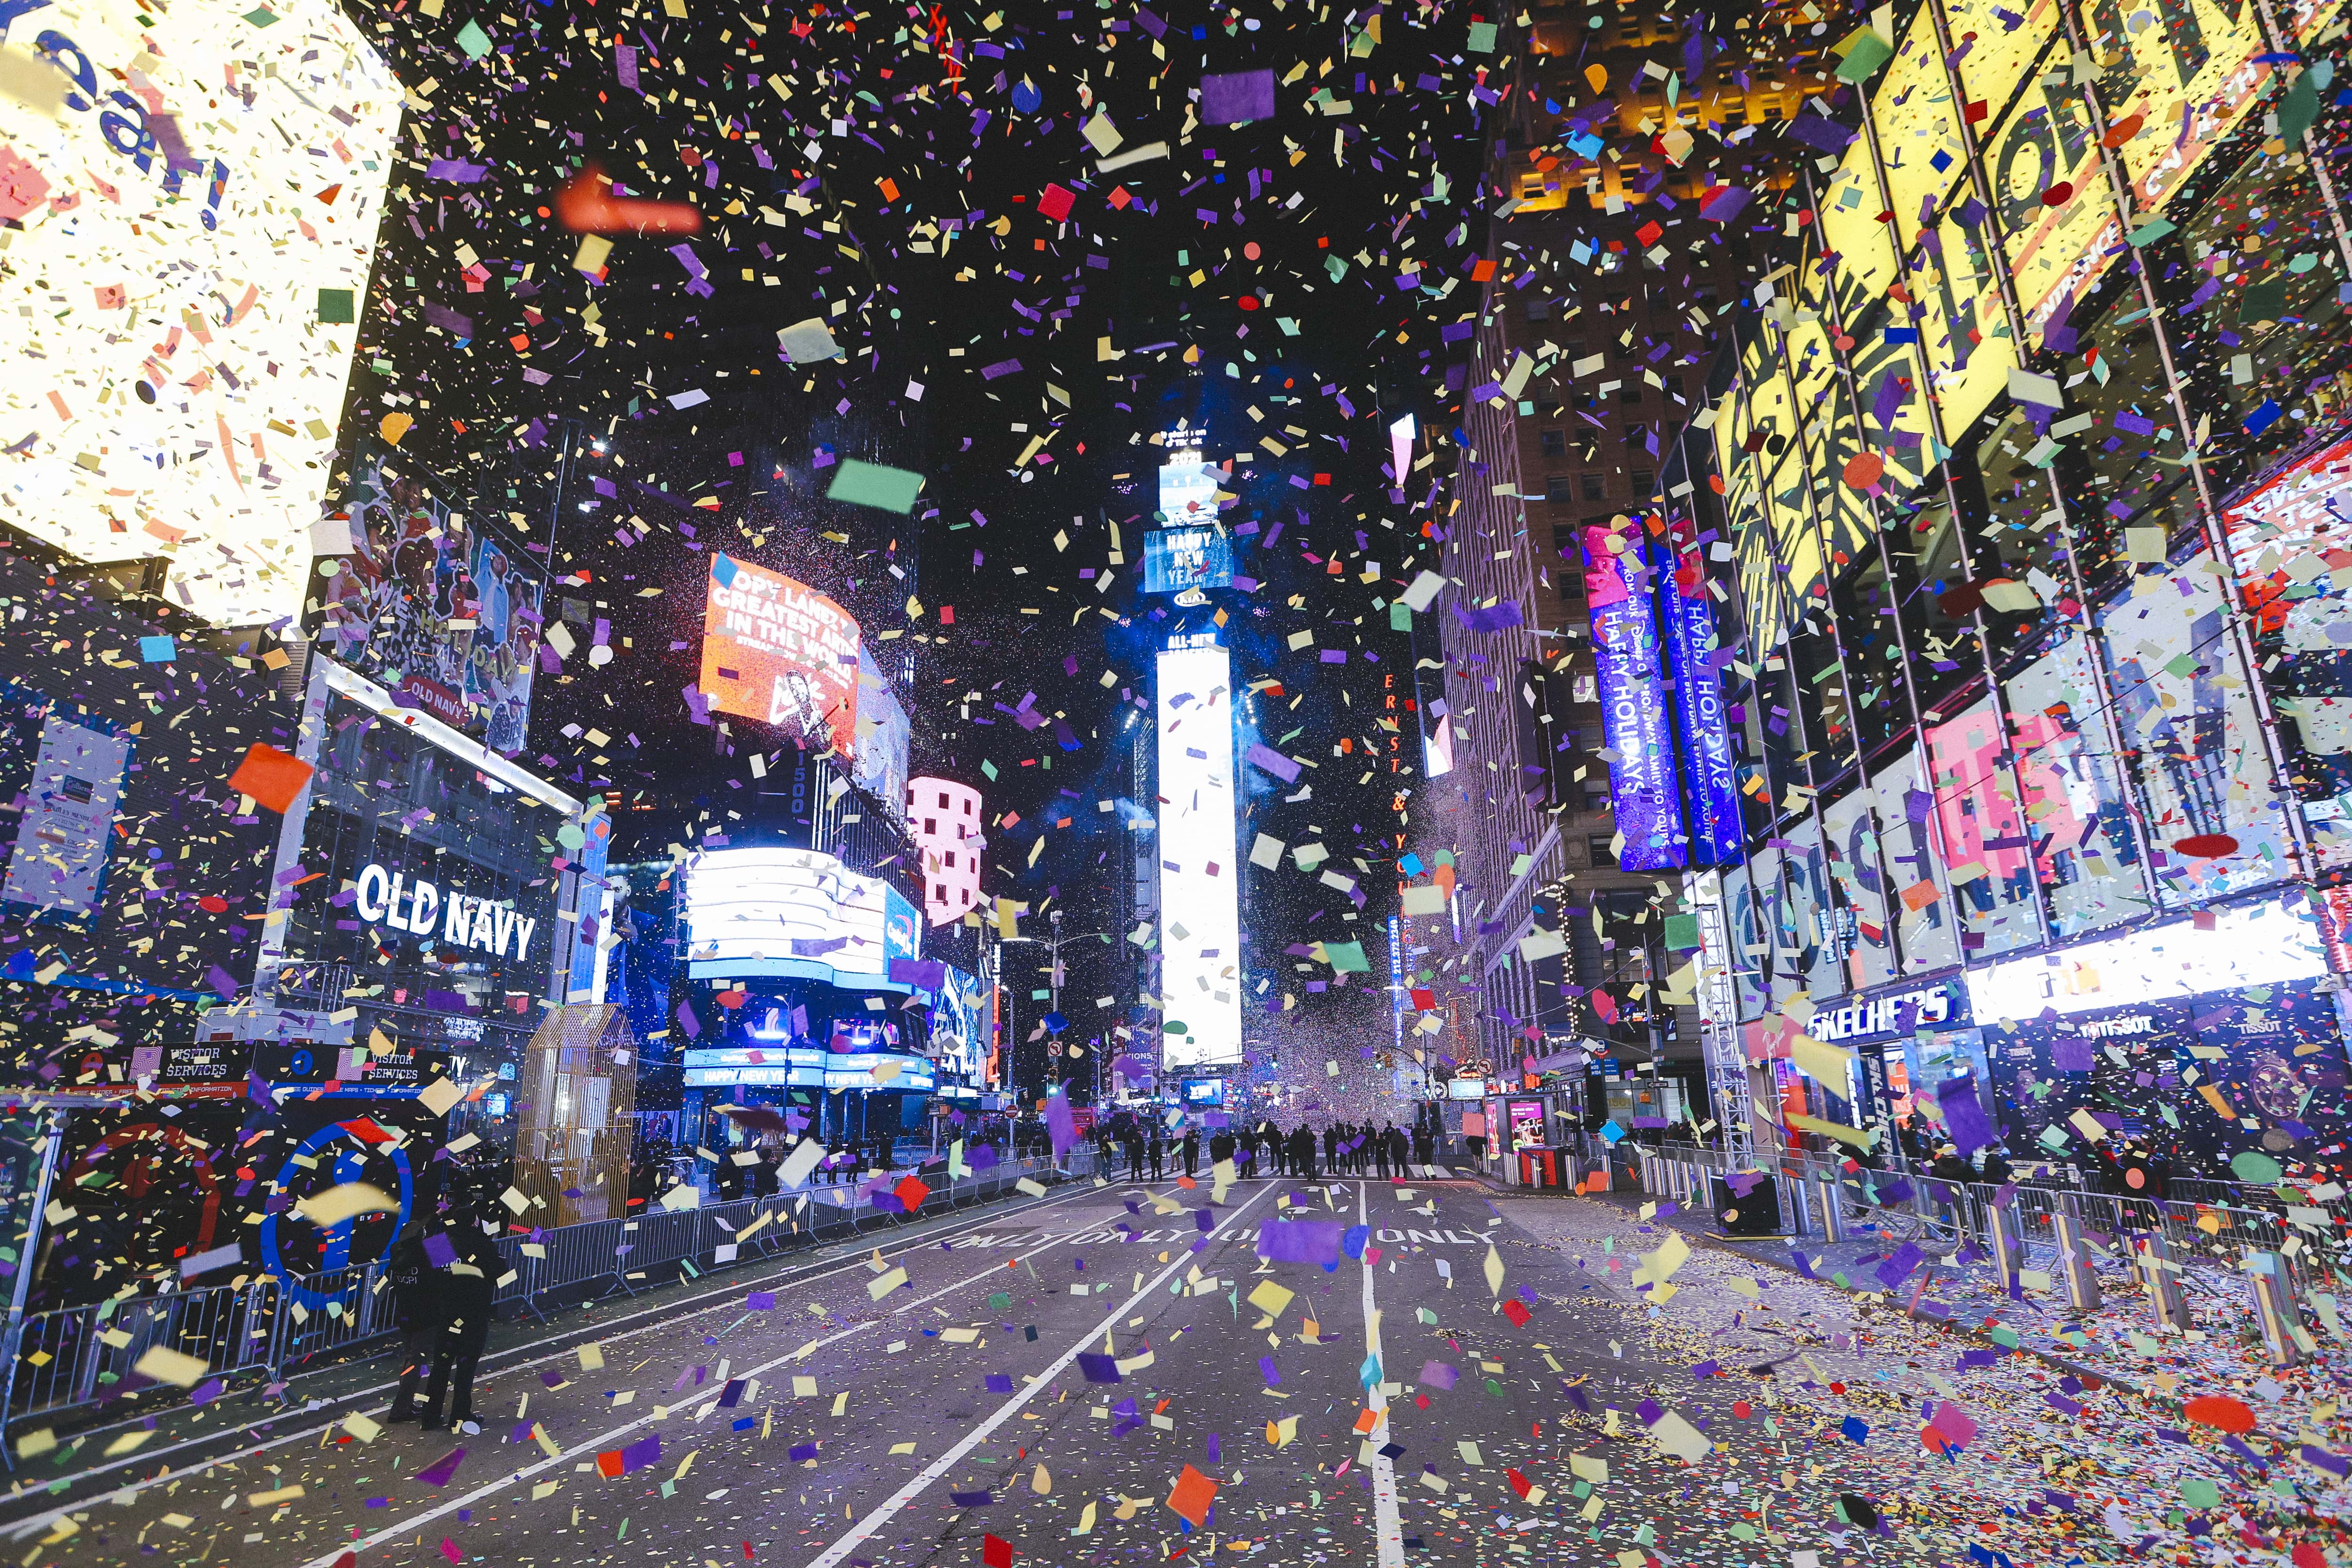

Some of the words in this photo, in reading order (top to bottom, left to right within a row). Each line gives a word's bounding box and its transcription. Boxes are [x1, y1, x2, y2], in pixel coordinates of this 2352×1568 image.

[1169, 452, 1202, 465] 2021
[1167, 532, 1212, 550] HAPPY
[1174, 550, 1204, 567] NEW
[712, 588, 819, 639] GREATEST
[726, 610, 752, 636] IN
[758, 620, 798, 651] THE
[420, 609, 516, 684] HOLIDAY
[411, 682, 433, 703] OLD
[434, 693, 463, 719] NAVY
[1384, 674, 1400, 773] ERNST
[1613, 685, 1645, 794] HOLIDAYS
[1648, 754, 1662, 786] AMILY
[792, 753, 806, 813] 1500
[1654, 790, 1664, 805] TO
[357, 864, 439, 935] OLD
[444, 891, 536, 962] NAVY
[1808, 985, 1947, 1042] SKECHERS
[2098, 1016, 2154, 1035] TISSOT
[2240, 1019, 2282, 1034] TISSOT
[372, 1053, 413, 1065] VISITOR
[167, 1064, 227, 1076] SERVICES
[369, 1068, 418, 1079] SERVICES
[704, 1070, 738, 1082] HAPPY
[739, 1070, 768, 1082] NEW
[769, 1070, 800, 1082] YEAR
[835, 1074, 860, 1084] NEW
[1376, 1229, 1498, 1244] ONLY
